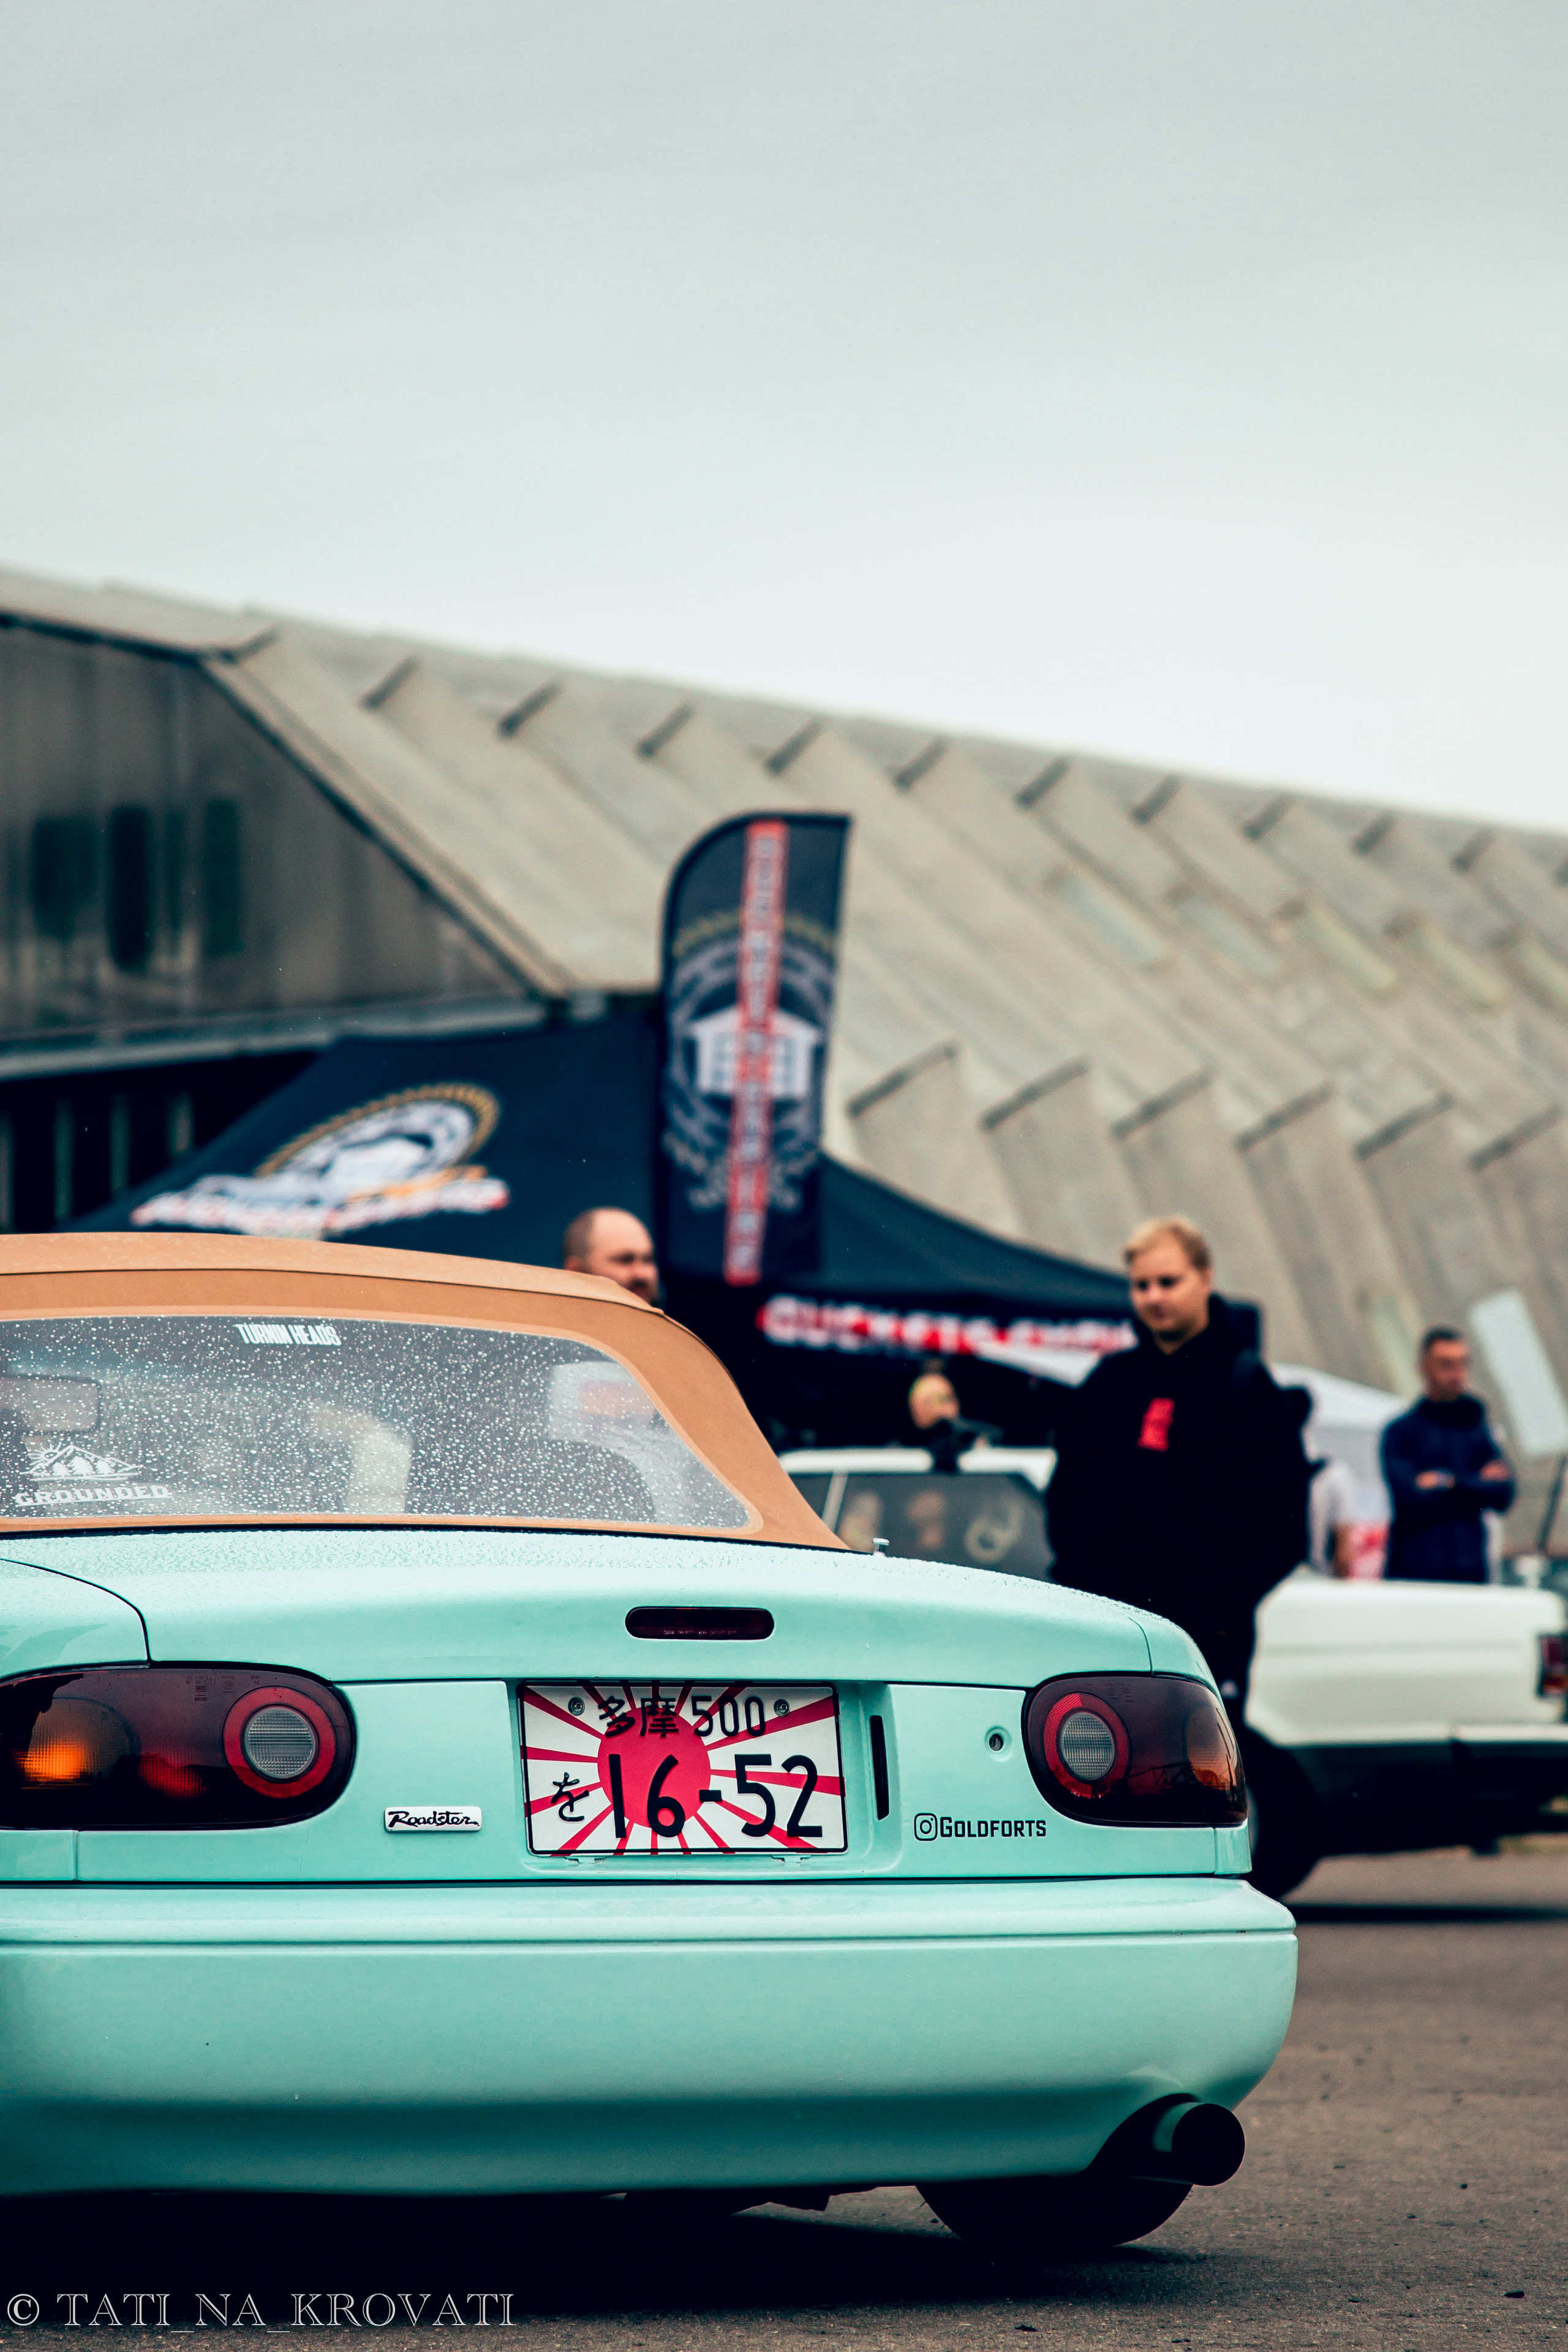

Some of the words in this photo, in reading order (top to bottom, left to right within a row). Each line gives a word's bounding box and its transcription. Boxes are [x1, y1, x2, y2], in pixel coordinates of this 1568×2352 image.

[233, 1324, 293, 1344] TURNIN
[287, 1325, 342, 1346] HEADS
[15, 1485, 173, 1506] GROUNDED
[598, 1695, 679, 1737] 多摩
[692, 1695, 766, 1737] 500
[551, 1771, 589, 1822] を
[609, 1754, 823, 1839] 16-52
[388, 1811, 480, 1828] Roadster
[940, 1816, 1046, 1838] GOLDFORTS
